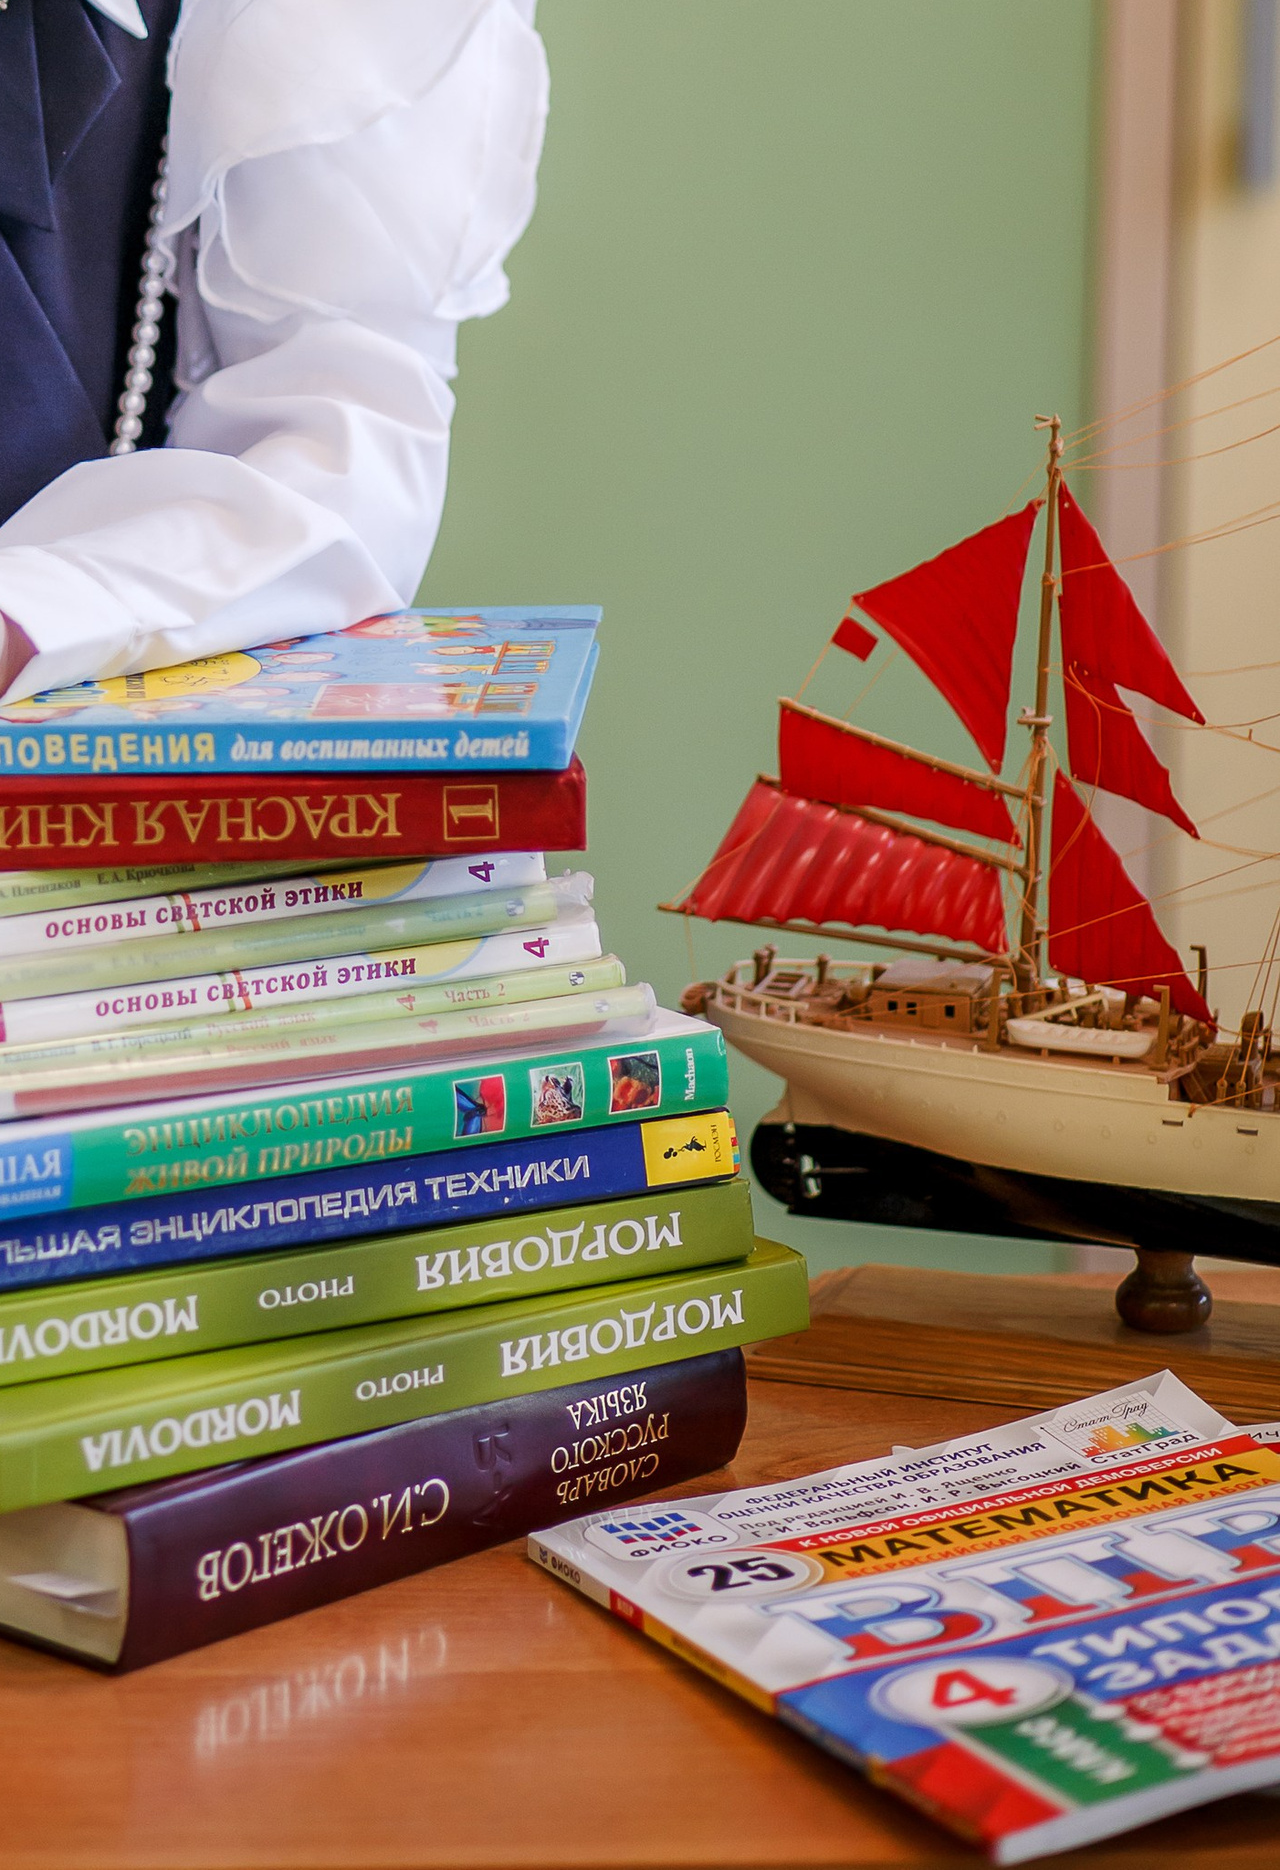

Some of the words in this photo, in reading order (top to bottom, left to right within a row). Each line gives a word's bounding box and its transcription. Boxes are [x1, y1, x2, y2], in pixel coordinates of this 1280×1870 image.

[230, 732, 274, 762] для
[280, 735, 449, 762] воспитанных
[454, 731, 530, 760] детей
[133, 792, 403, 846] КРАСНАЯ
[468, 861, 495, 883] 4
[45, 910, 147, 939] ОСНОВЫ
[156, 887, 276, 924] СВЕТСКОЙ
[285, 880, 364, 908] ЭТИКИ
[523, 937, 550, 959] 4
[96, 987, 198, 1017] ОСНОВЫ
[207, 964, 328, 1002] СВЕТСКОЙ
[337, 958, 417, 984] ЭТИКИ
[444, 987, 491, 1005] Часть
[497, 983, 507, 998] 2
[683, 1047, 695, 1102] Machaon
[123, 1085, 414, 1156] ЭНЦИКЛОПЕДИЯ
[124, 1144, 249, 1195] ЖИВОЙ
[257, 1126, 414, 1174] ПРИРОДЫ
[130, 1180, 418, 1246] ЭНЦИКЛОПЕДИЯ
[424, 1155, 591, 1201] ТЕХНИКИ
[415, 1211, 684, 1292] МОРДОВИЯ
[258, 1275, 355, 1310] PHOTO
[500, 1289, 745, 1378] МОРДОВИЯ
[355, 1364, 445, 1402] PHOTO
[566, 1380, 648, 1430] ЯЗЫКА
[80, 1388, 302, 1473] MORDOVIA
[550, 1411, 671, 1474] РУССКОГО
[1090, 1433, 1200, 1466] СтатГрад
[556, 1452, 660, 1506] СЛОВАРЬ
[717, 1498, 802, 1521] ОЦЕНКИ
[802, 1479, 902, 1507] КАЧЕСТВА
[902, 1441, 1048, 1483] ОБРАЗОВАНИЯ
[738, 1517, 780, 1531] Под
[783, 1495, 888, 1526] редакцией
[942, 1466, 1018, 1492] Ященко
[745, 1467, 897, 1505] ФЕДЕРАЛЬНЫЙ
[898, 1443, 994, 1472] ИНСТИТУТ
[799, 1539, 818, 1549] К
[818, 1521, 901, 1545] НОВОЙ
[902, 1482, 1074, 1527] ОФИЦИАЛЬНОЙ
[1074, 1447, 1223, 1491] ДЕМОВЕРСИИ
[974, 1461, 1081, 1495] Высоцкий
[817, 1462, 1262, 1568] МАТЕМАТИКА
[844, 1534, 1032, 1579] ВСЕРОССИЙСКАЯ
[1033, 1495, 1193, 1540] ПРОВЕРОЧНАЯ
[1195, 1476, 1278, 1503] РАБОТА
[196, 1503, 370, 1602] ОЖЕГОВ
[550, 1555, 582, 1585] ФИОКО
[629, 1533, 728, 1559] ФИОКО
[686, 1555, 796, 1592] 25
[757, 1495, 1280, 1663] ВПР
[932, 1670, 1018, 1711] 4
